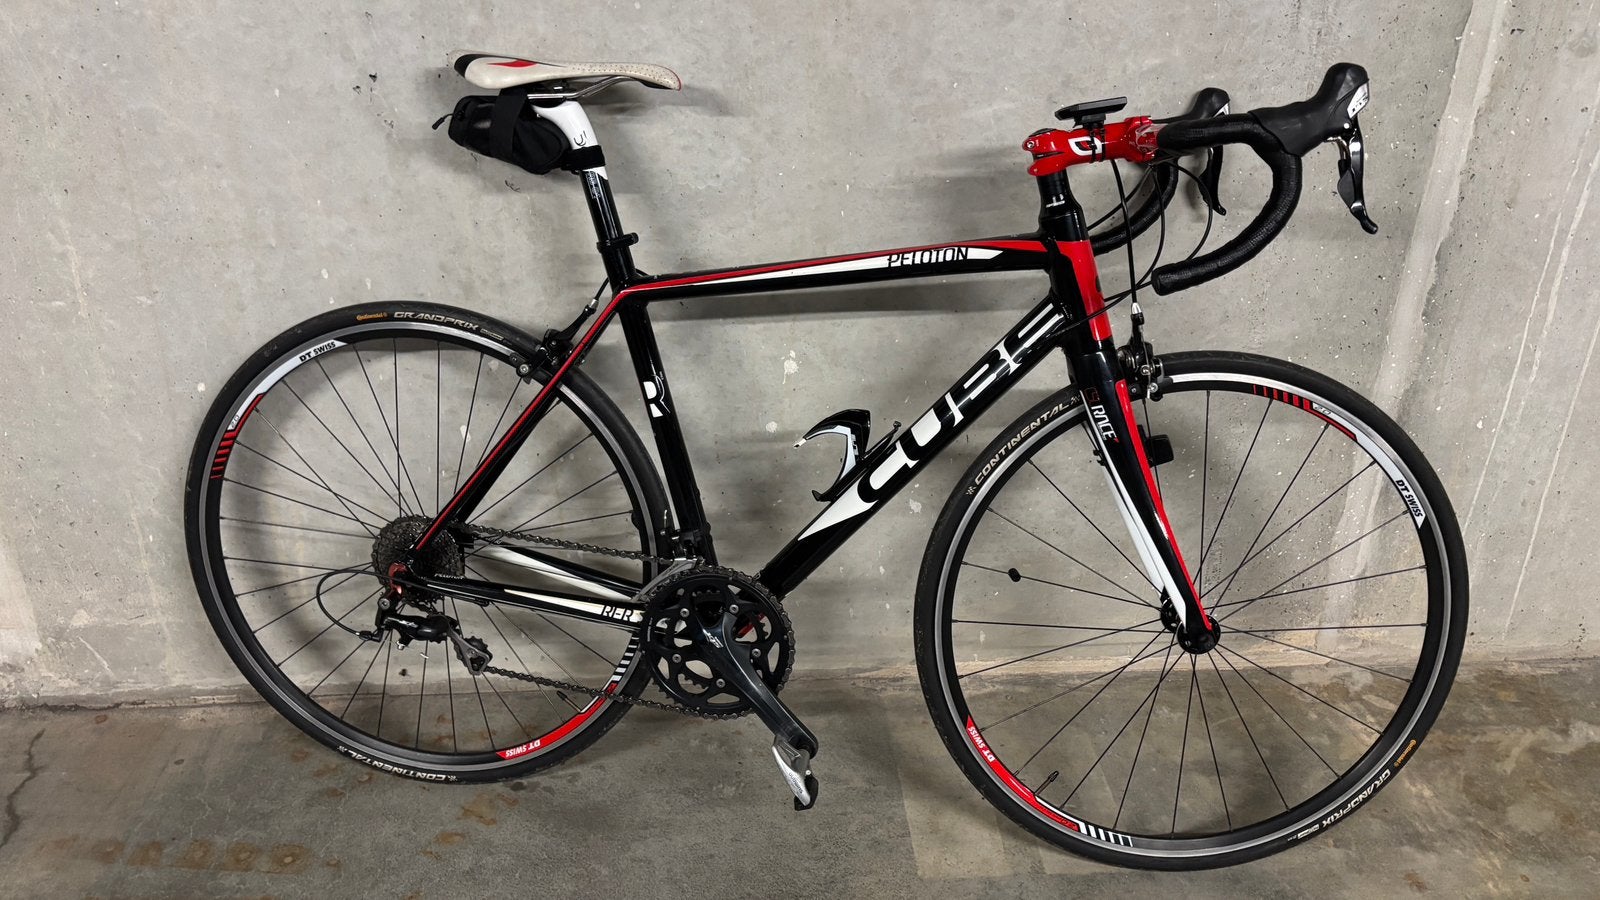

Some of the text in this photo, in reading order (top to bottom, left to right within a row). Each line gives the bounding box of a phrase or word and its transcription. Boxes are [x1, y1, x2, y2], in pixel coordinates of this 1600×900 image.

[887, 246, 968, 268] PELOTON
[394, 310, 480, 331] GRANDPRIX
[299, 341, 336, 361] DT SWISS
[857, 300, 1065, 504] CUBE
[1091, 404, 1117, 439] RACE
[974, 401, 1069, 486] CONTINENTAL
[1395, 479, 1423, 518] DT SWISS
[505, 739, 541, 758] DT SWISS
[968, 726, 996, 762] DT SWISS
[348, 749, 446, 781] CONTINENTAL
[1322, 768, 1391, 828] GRANDPRIX
